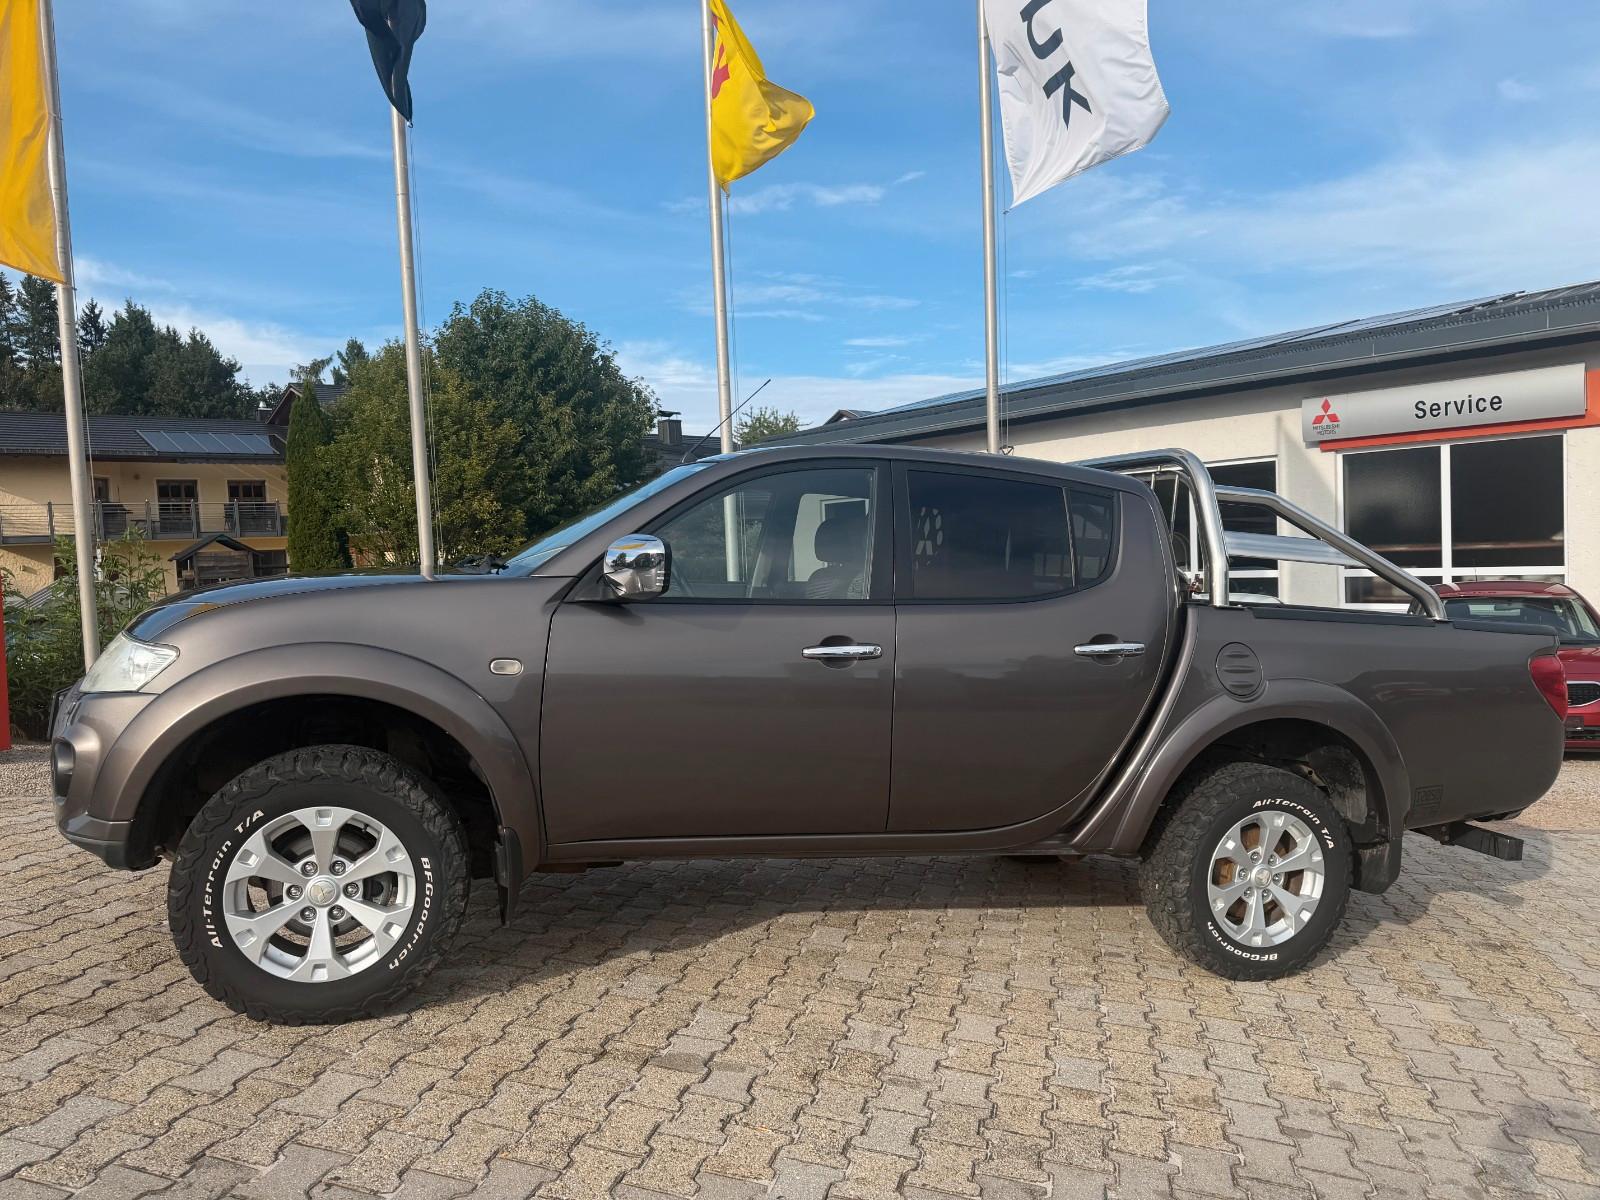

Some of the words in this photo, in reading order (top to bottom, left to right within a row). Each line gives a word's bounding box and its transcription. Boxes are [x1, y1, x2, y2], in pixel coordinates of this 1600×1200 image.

[1414, 396, 1502, 420] Service
[1253, 798, 1320, 825] All-Terrain
[1321, 828, 1336, 849] T/A
[203, 840, 232, 948] All-Terrain
[235, 809, 265, 834] T/A
[390, 857, 433, 970] BFGoodrich
[1208, 922, 1277, 961] BFGoodrich
